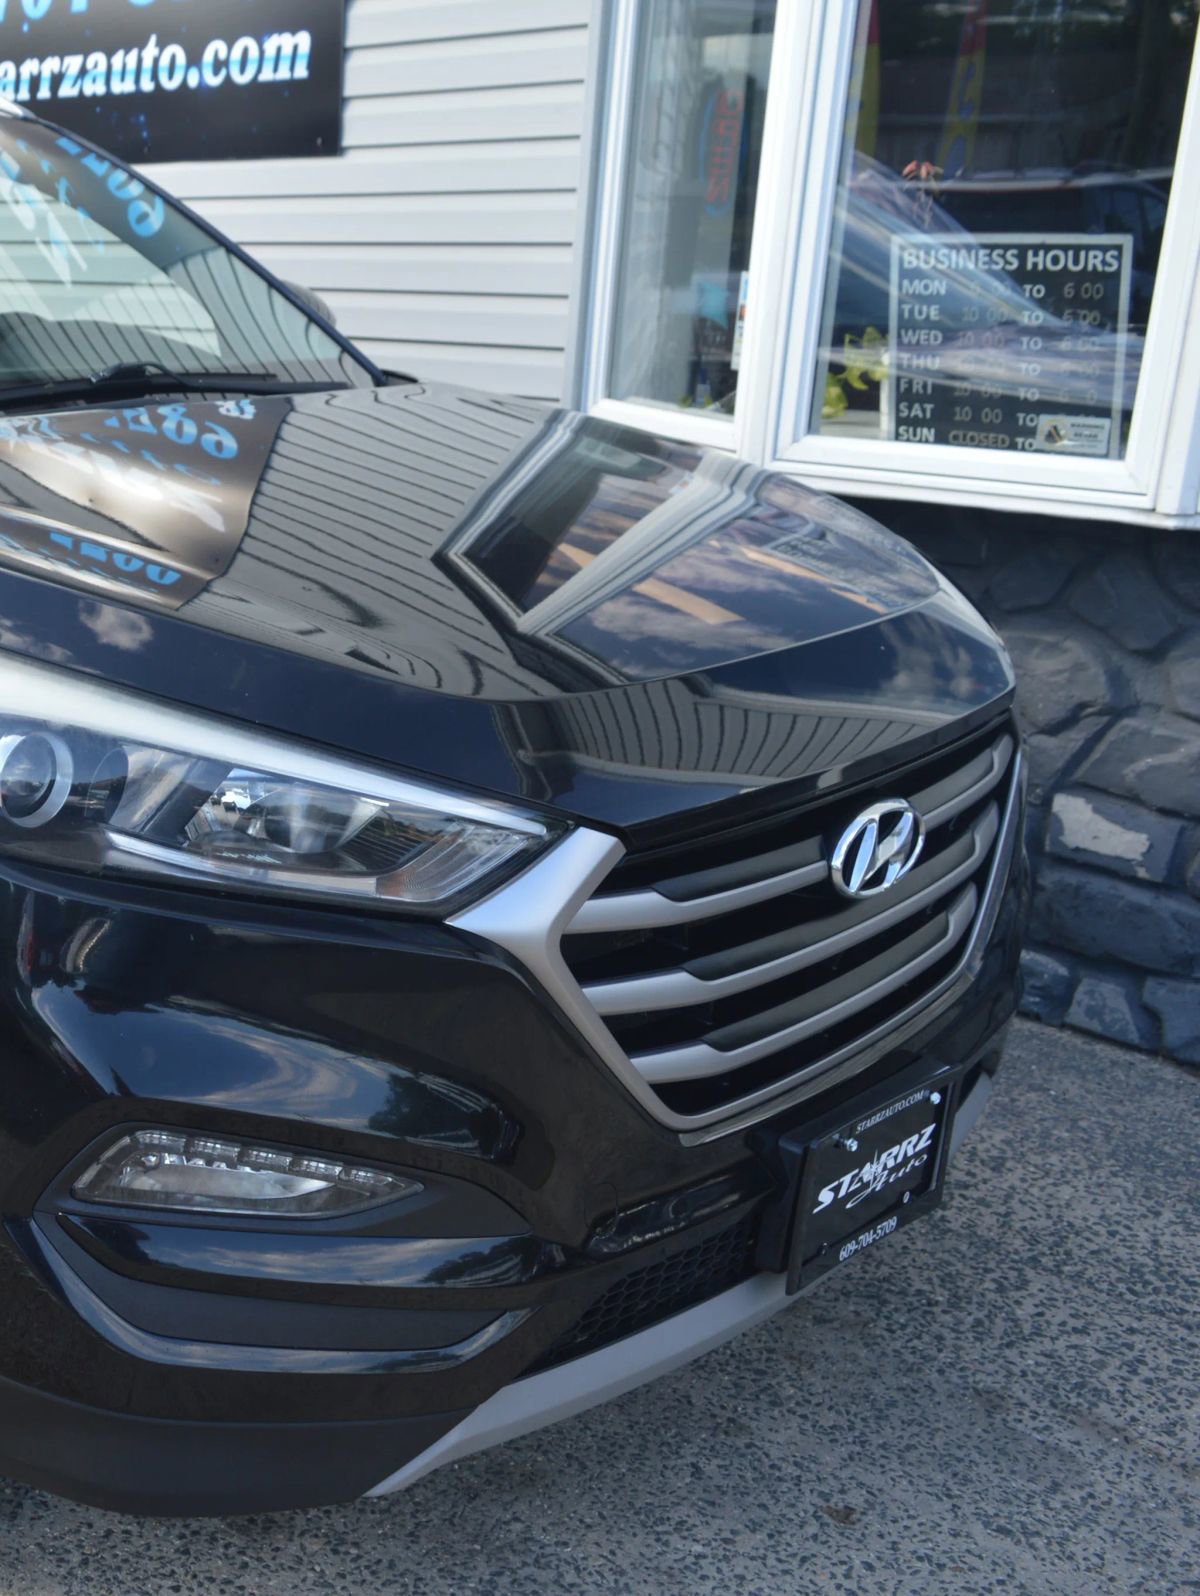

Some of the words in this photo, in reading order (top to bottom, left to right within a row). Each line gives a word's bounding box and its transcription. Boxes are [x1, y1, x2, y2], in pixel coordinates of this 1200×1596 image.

[903, 249, 1019, 270] BUSINESS
[1026, 249, 1119, 272] HOURS
[901, 279, 947, 295] MON
[1023, 284, 1046, 298] TO
[901, 304, 941, 320] TUE
[1022, 311, 1044, 326] TO
[900, 330, 943, 345] WED
[1020, 336, 1043, 350] TO
[900, 352, 941, 369] THU
[1019, 363, 1041, 376] TO
[900, 379, 933, 395] FRI
[1018, 388, 1039, 402] TO
[899, 402, 935, 419] SAT
[954, 406, 973, 422] 10
[981, 408, 1003, 424] 00
[1016, 412, 1038, 427] TO
[898, 425, 935, 442] SUN
[950, 431, 1010, 448] CLOSED
[1014, 437, 1036, 451] TO
[855, 1089, 925, 1134] STARRZAUTO.COM
[812, 1122, 937, 1214] STARRZ
[838, 1215, 898, 1261] 609-704-5709
